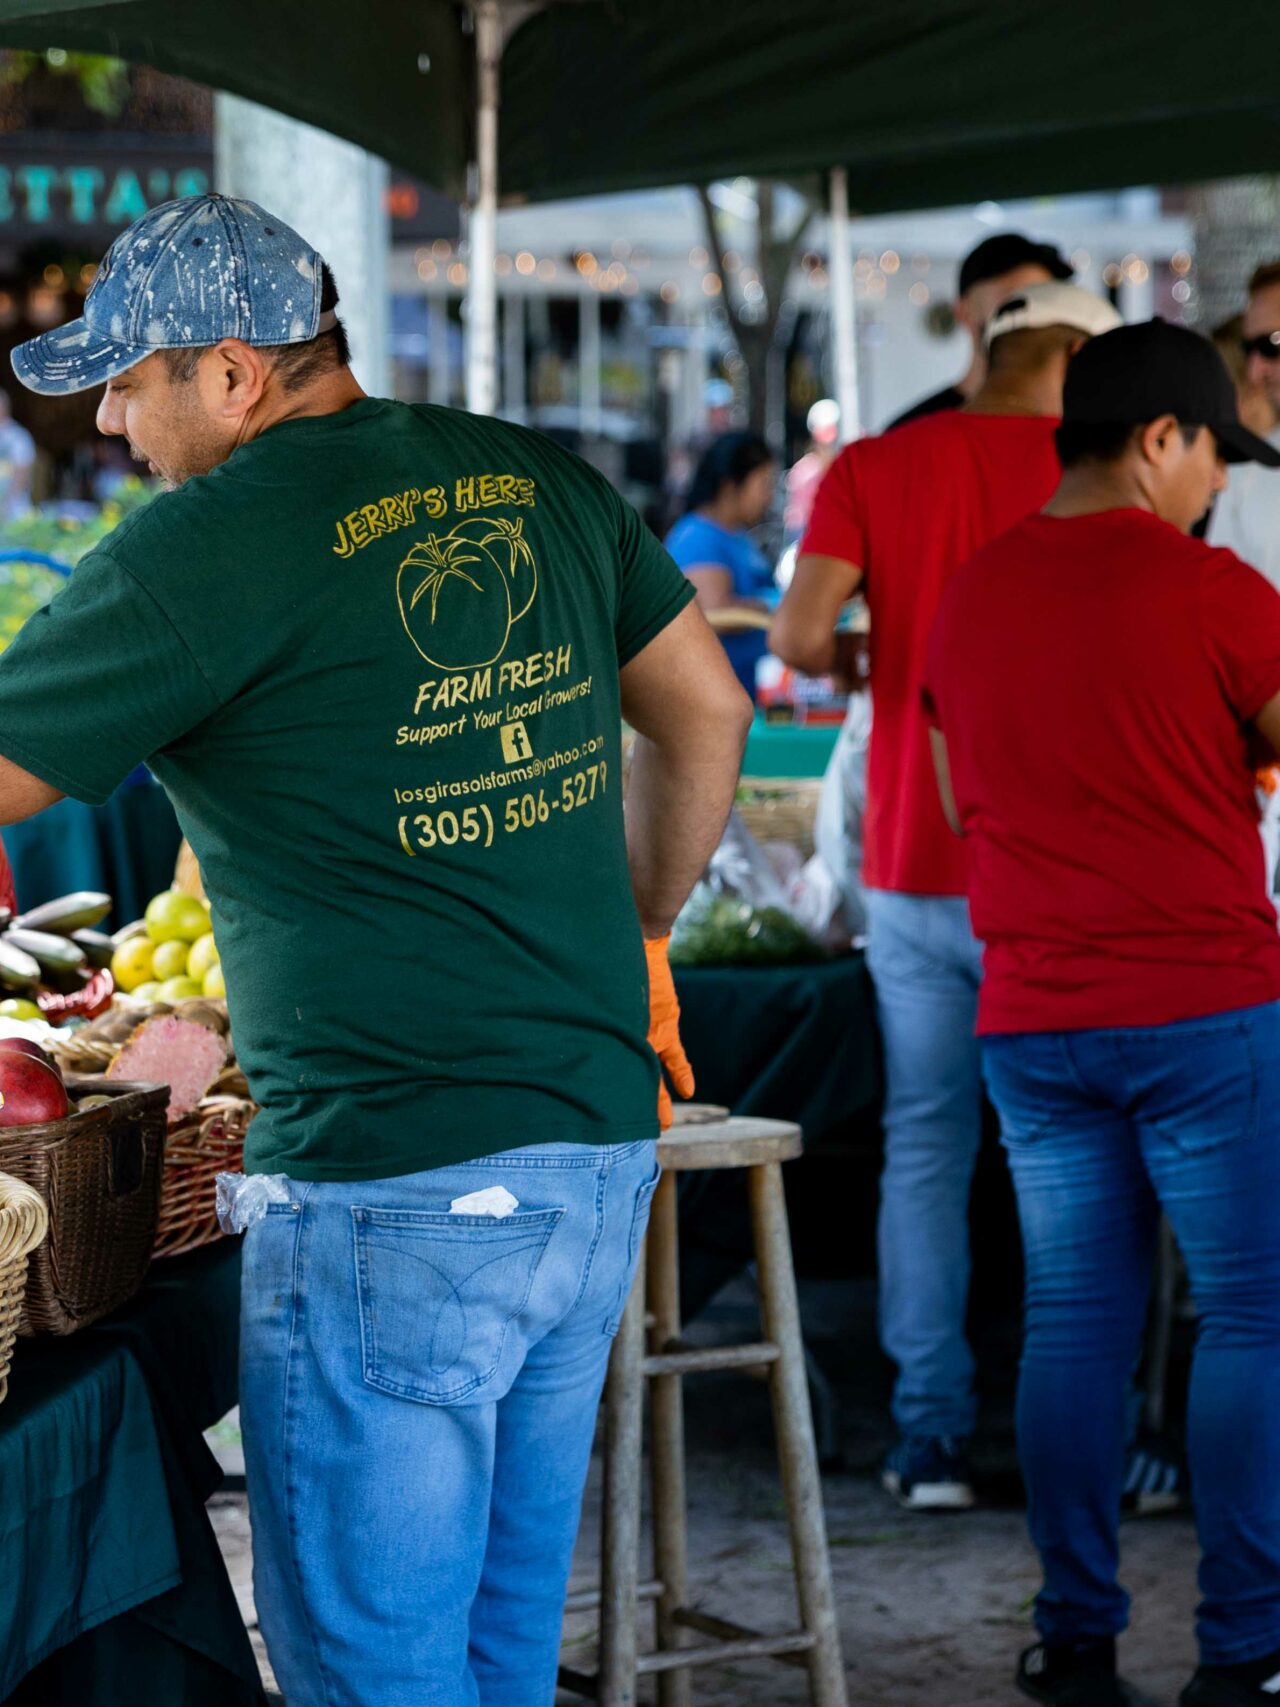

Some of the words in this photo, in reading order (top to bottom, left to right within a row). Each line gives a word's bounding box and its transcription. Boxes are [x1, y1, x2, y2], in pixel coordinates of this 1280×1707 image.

[332, 485, 448, 558] JERRY'S
[455, 474, 536, 513] HERE
[395, 713, 468, 746] Support
[473, 709, 504, 731] Your
[506, 694, 543, 722] Local
[544, 675, 593, 709] Growers!
[413, 667, 492, 715] FARM
[498, 643, 572, 696] FRESH
[393, 735, 605, 804] losgirasolsfarms@yahoo.com
[397, 803, 495, 857] (305)
[503, 760, 608, 834] 506-5279
